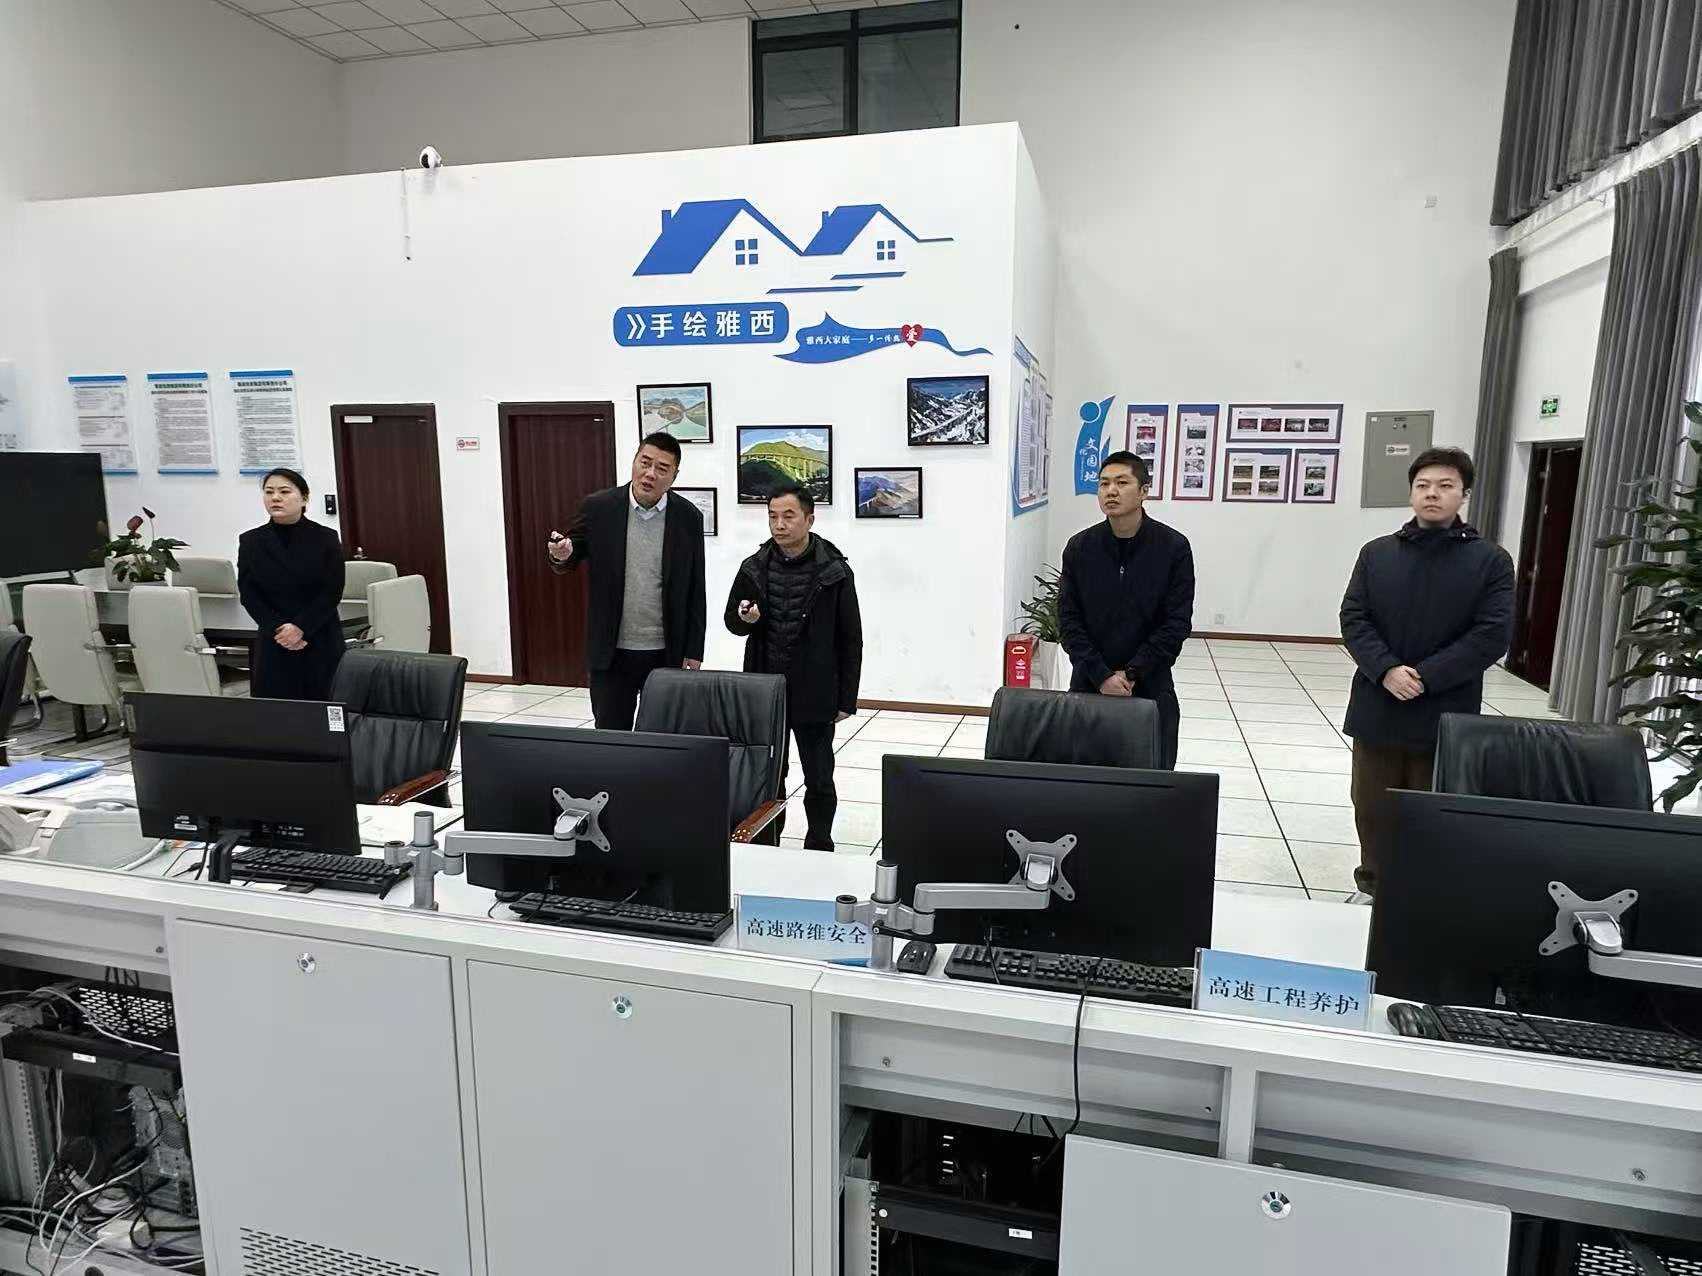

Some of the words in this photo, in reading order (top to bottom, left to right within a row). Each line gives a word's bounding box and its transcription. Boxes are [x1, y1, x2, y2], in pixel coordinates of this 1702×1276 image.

[650, 310, 775, 338] 手绘雅西
[747, 918, 866, 944] 高速路维安全
[1209, 976, 1359, 1015] 高速工程养护
